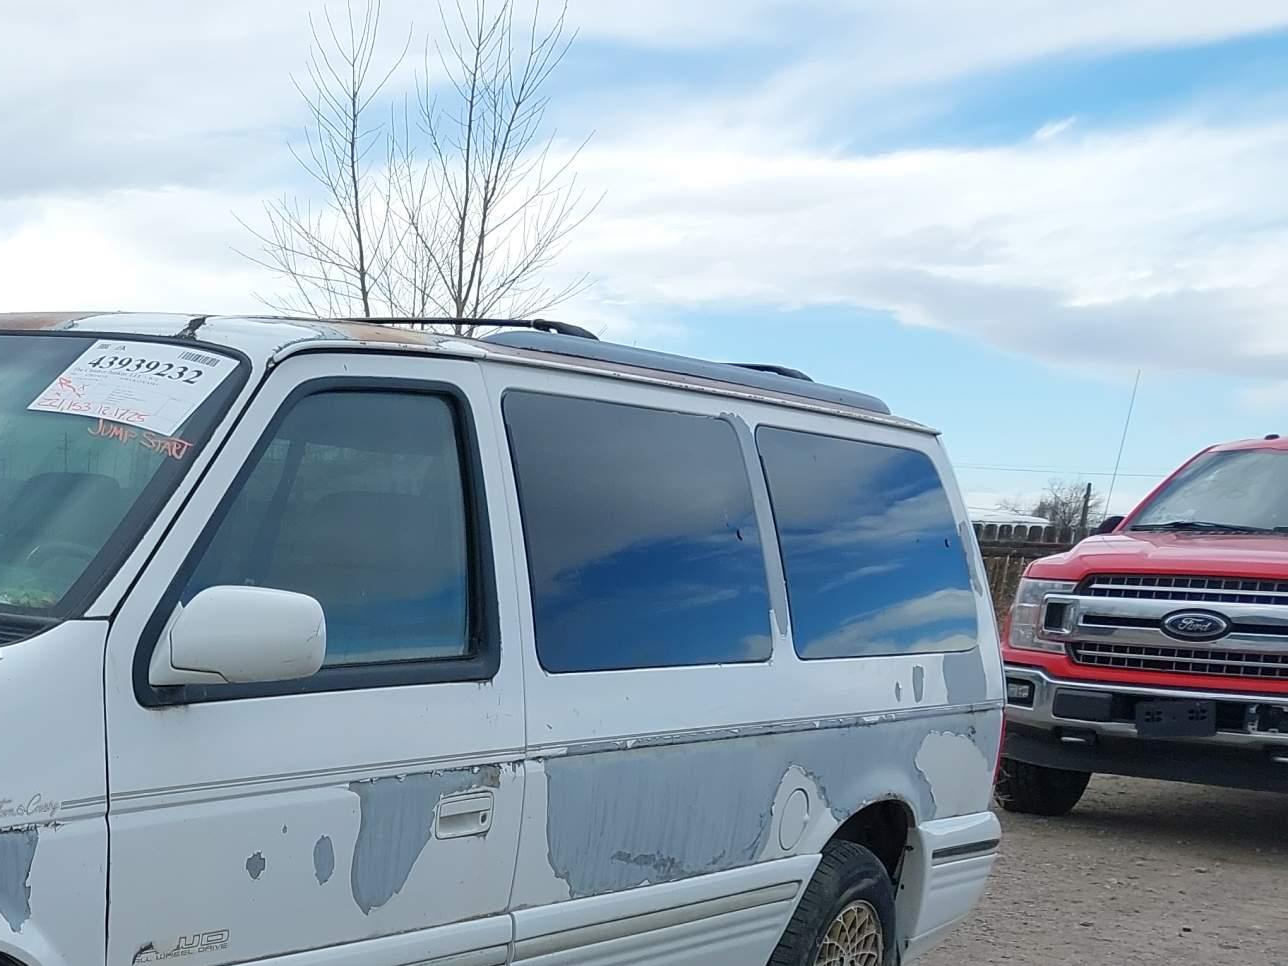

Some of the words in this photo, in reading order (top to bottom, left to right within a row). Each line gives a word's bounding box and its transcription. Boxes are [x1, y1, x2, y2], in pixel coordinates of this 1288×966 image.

[88, 355, 204, 385] 43939232
[88, 417, 137, 443] JUMP
[140, 431, 194, 460] START
[1178, 617, 1212, 632] Ford
[197, 942, 228, 954] DRIVE
